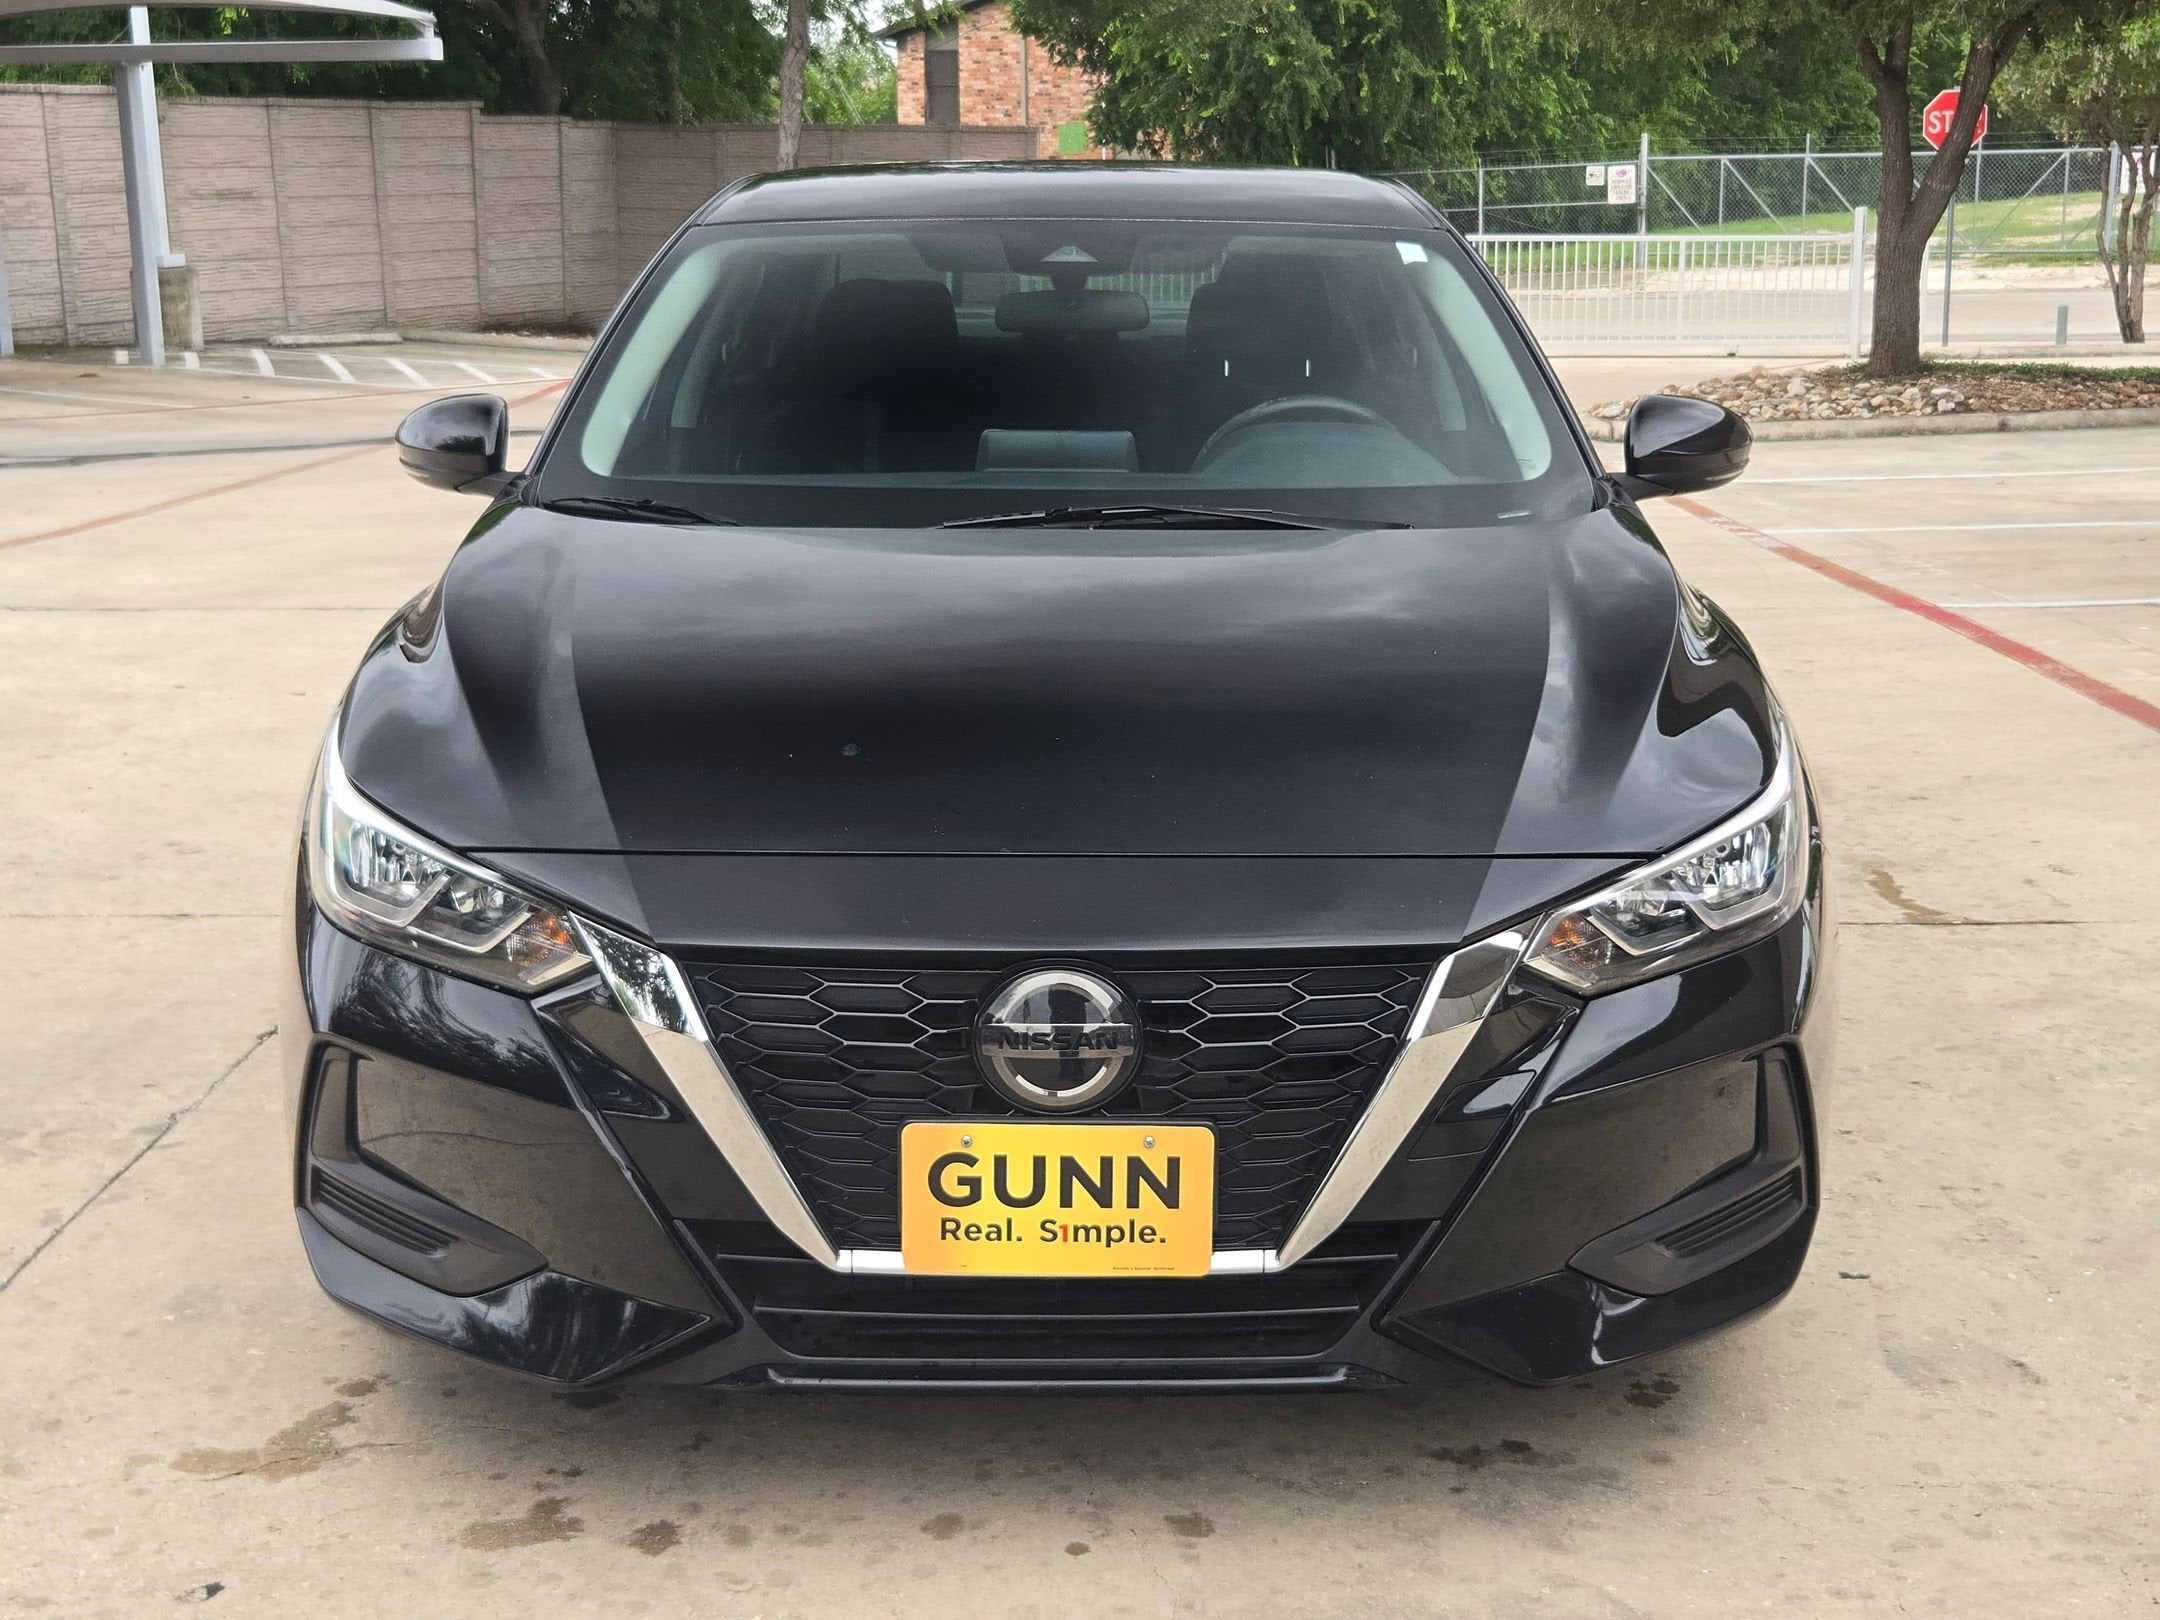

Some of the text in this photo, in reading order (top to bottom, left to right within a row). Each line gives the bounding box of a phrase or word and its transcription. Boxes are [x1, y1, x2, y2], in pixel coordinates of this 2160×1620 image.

[998, 1032, 1118, 1050] NISSAN
[928, 1152, 1180, 1209] GUNN
[940, 1217, 1023, 1242] Real.
